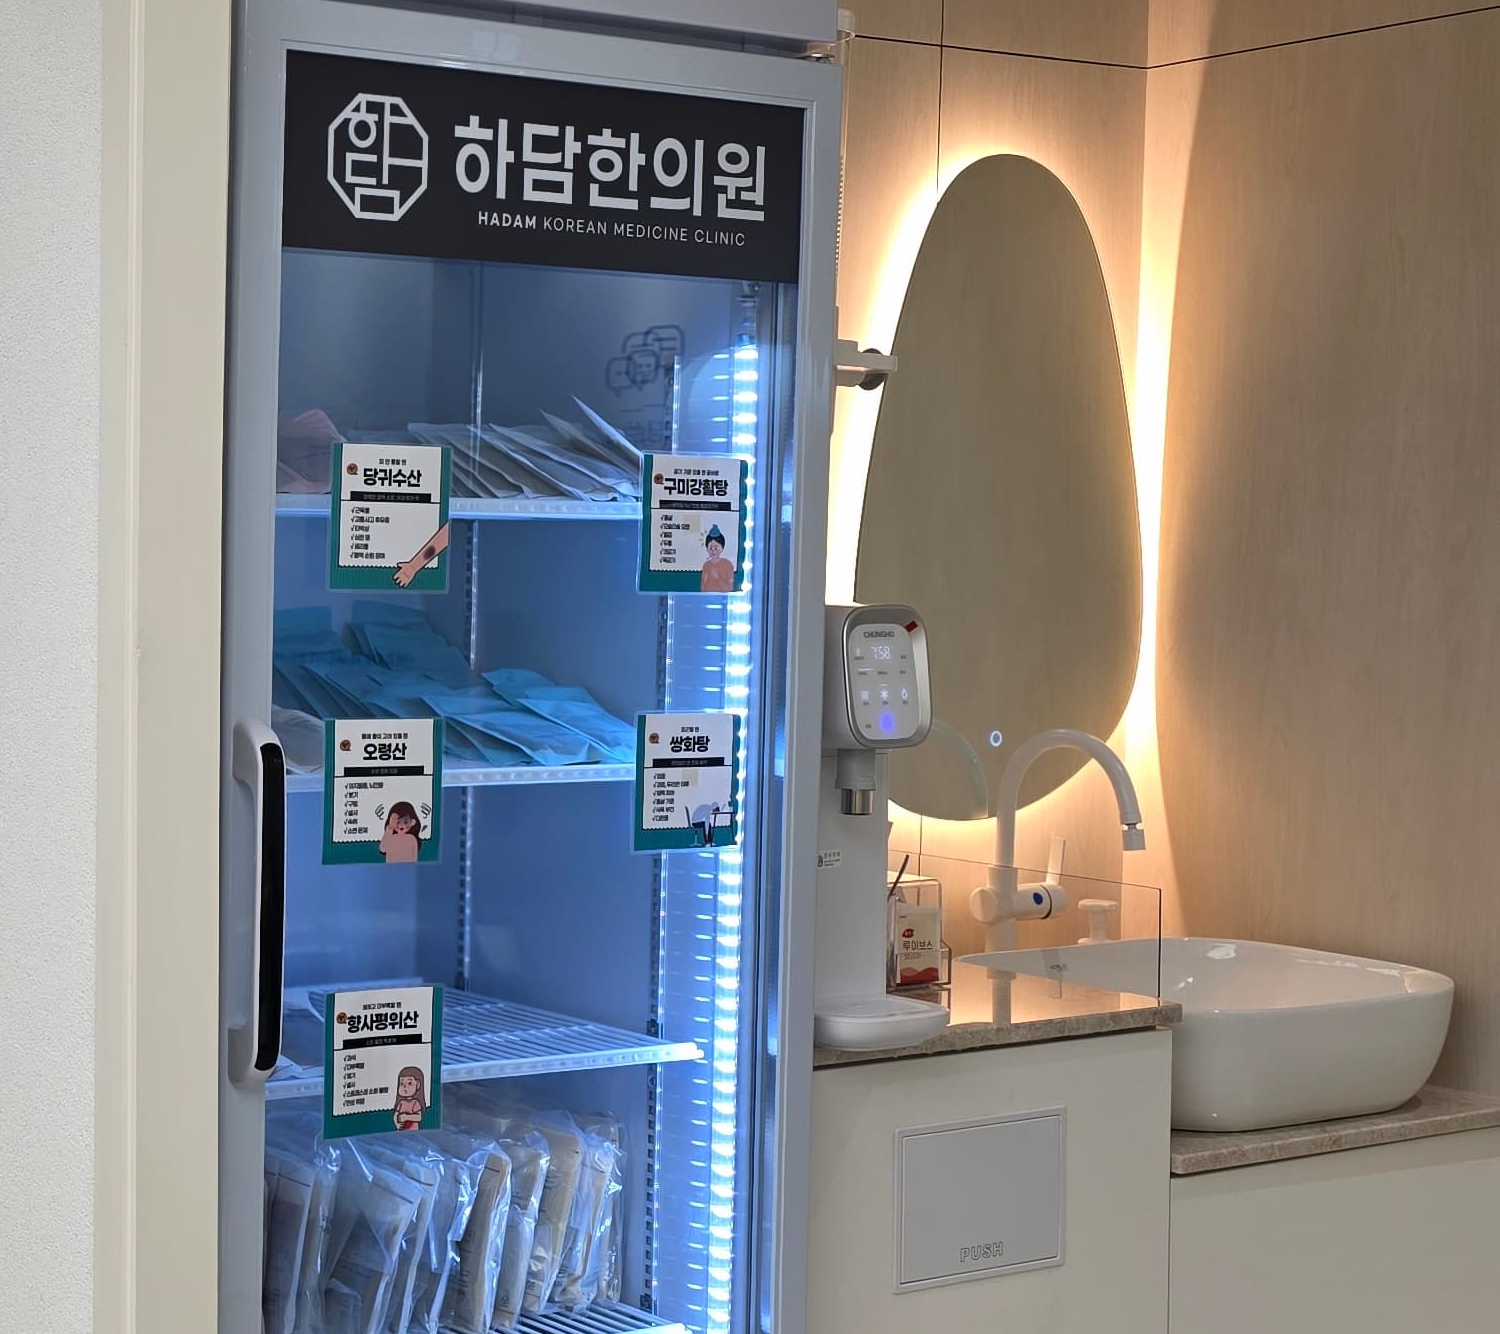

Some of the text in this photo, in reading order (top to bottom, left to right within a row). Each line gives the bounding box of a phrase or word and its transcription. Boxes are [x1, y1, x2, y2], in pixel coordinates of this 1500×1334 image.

[454, 114, 767, 223] 하담한의원
[477, 210, 747, 247] HADAM KOREAN MEDICINE CLINIC
[363, 467, 423, 488] 당귀수산
[664, 477, 729, 497] 구미강활탕
[363, 742, 408, 761] 오령산
[669, 735, 710, 753] 쌍화탕
[347, 1010, 420, 1034] 향사평위산
[959, 1241, 1004, 1262] PUSH
